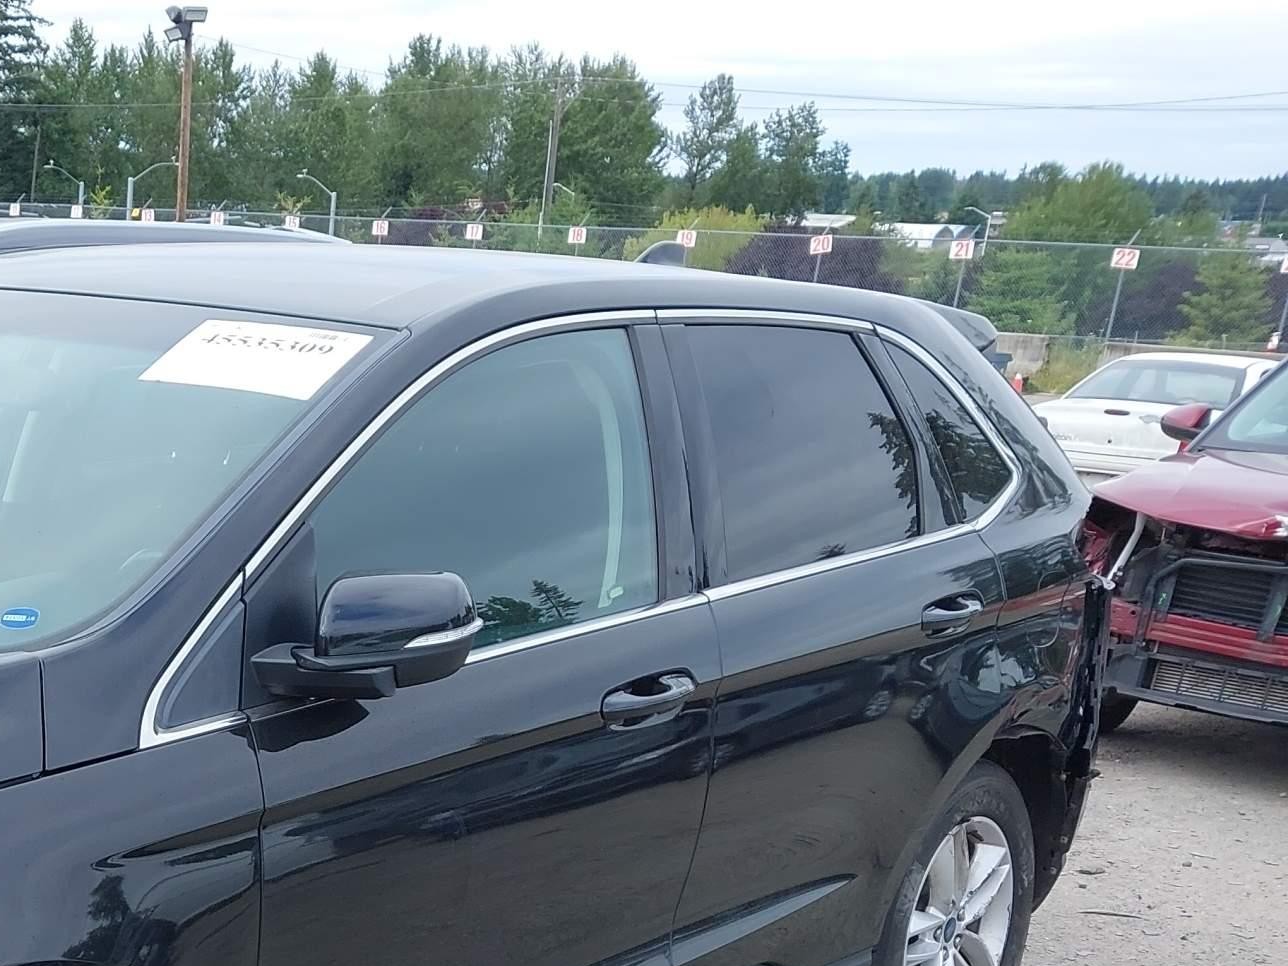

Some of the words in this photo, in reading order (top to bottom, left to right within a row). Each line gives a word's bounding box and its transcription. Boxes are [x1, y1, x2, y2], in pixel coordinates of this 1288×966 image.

[375, 221, 386, 234] 16
[469, 225, 480, 237] 17
[572, 228, 583, 241] 18
[681, 231, 692, 245] 19
[813, 236, 830, 252] 20
[955, 241, 970, 257] 21
[1114, 249, 1138, 267] 22
[201, 333, 334, 354] 45535309
